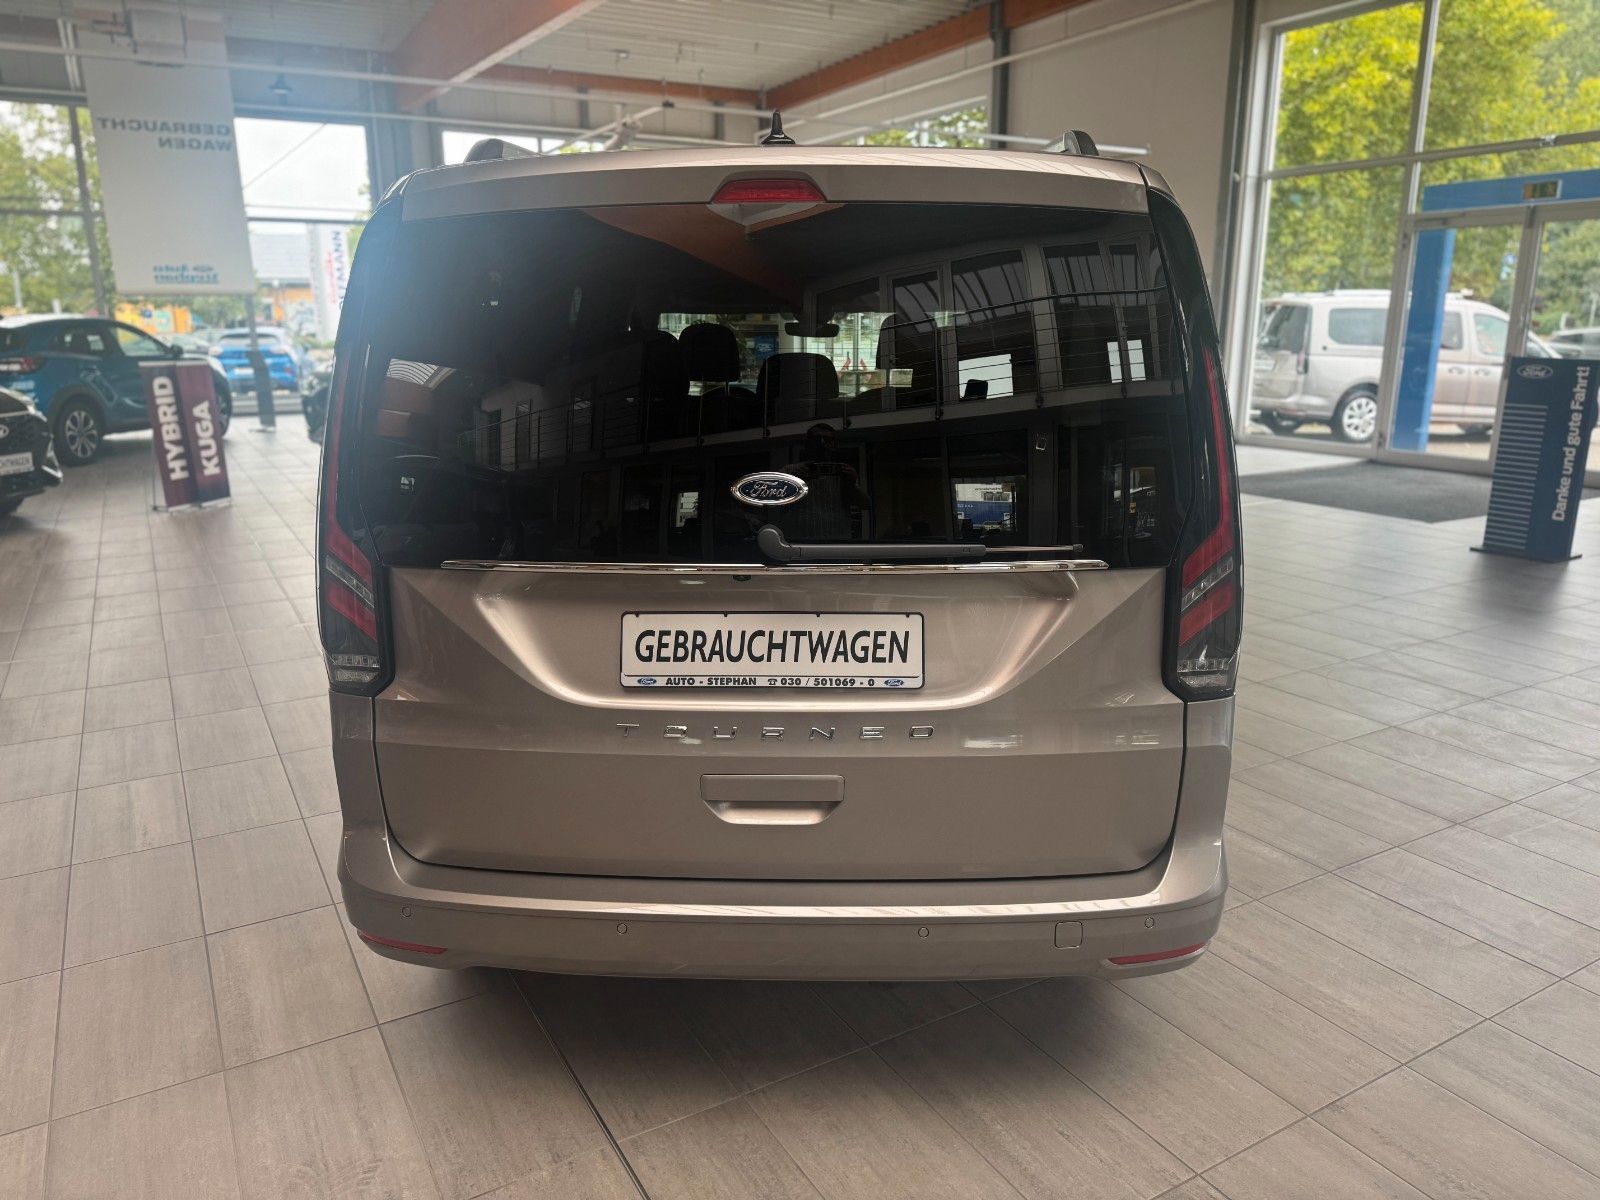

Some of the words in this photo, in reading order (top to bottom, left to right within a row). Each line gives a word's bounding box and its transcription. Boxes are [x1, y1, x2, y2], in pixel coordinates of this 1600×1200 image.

[1570, 366, 1590, 410] Fahrt!
[152, 376, 190, 481] HYBRID
[192, 400, 221, 476] KUGA
[1567, 411, 1583, 446] gute
[1562, 447, 1576, 475] und
[1551, 477, 1572, 522] Danke
[635, 629, 910, 663] GEBRAUCHTWAGEN
[665, 677, 696, 686] AUTO
[707, 677, 757, 686] STEPHAN
[780, 677, 801, 686] 030
[813, 678, 856, 687] 501069
[616, 722, 935, 740] TOURNEO
